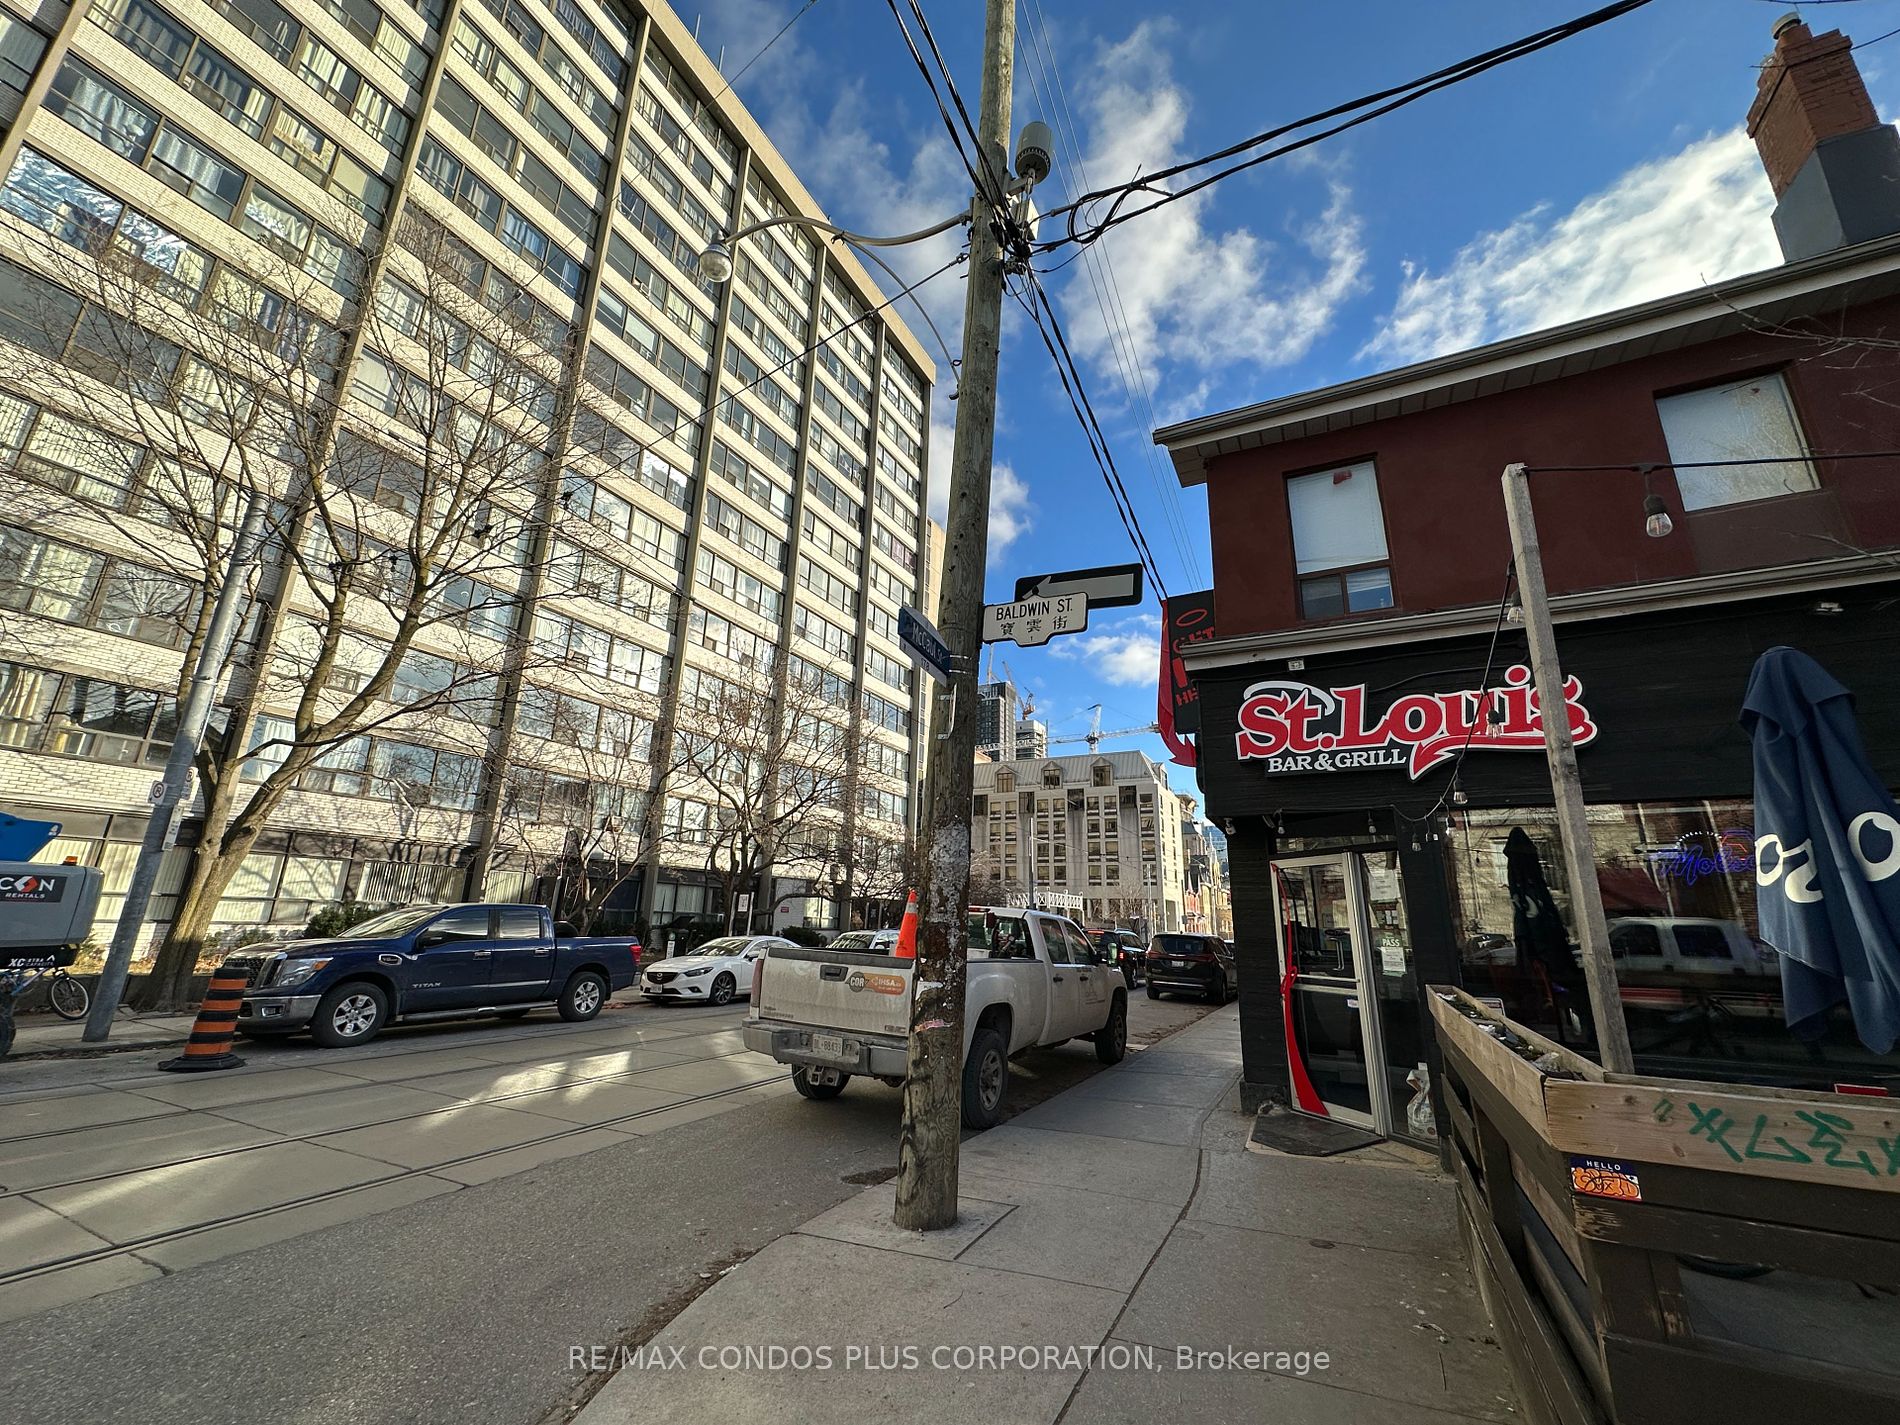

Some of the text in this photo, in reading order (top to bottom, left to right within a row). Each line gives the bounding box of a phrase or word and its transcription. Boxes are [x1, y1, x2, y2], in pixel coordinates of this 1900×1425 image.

[996, 597, 1073, 621] BALDWIN ST.
[912, 621, 937, 660] McCaul
[1382, 938, 1400, 947] PASS
[8, 958, 26, 967] XC
[1586, 1160, 1621, 1171] HELLO
